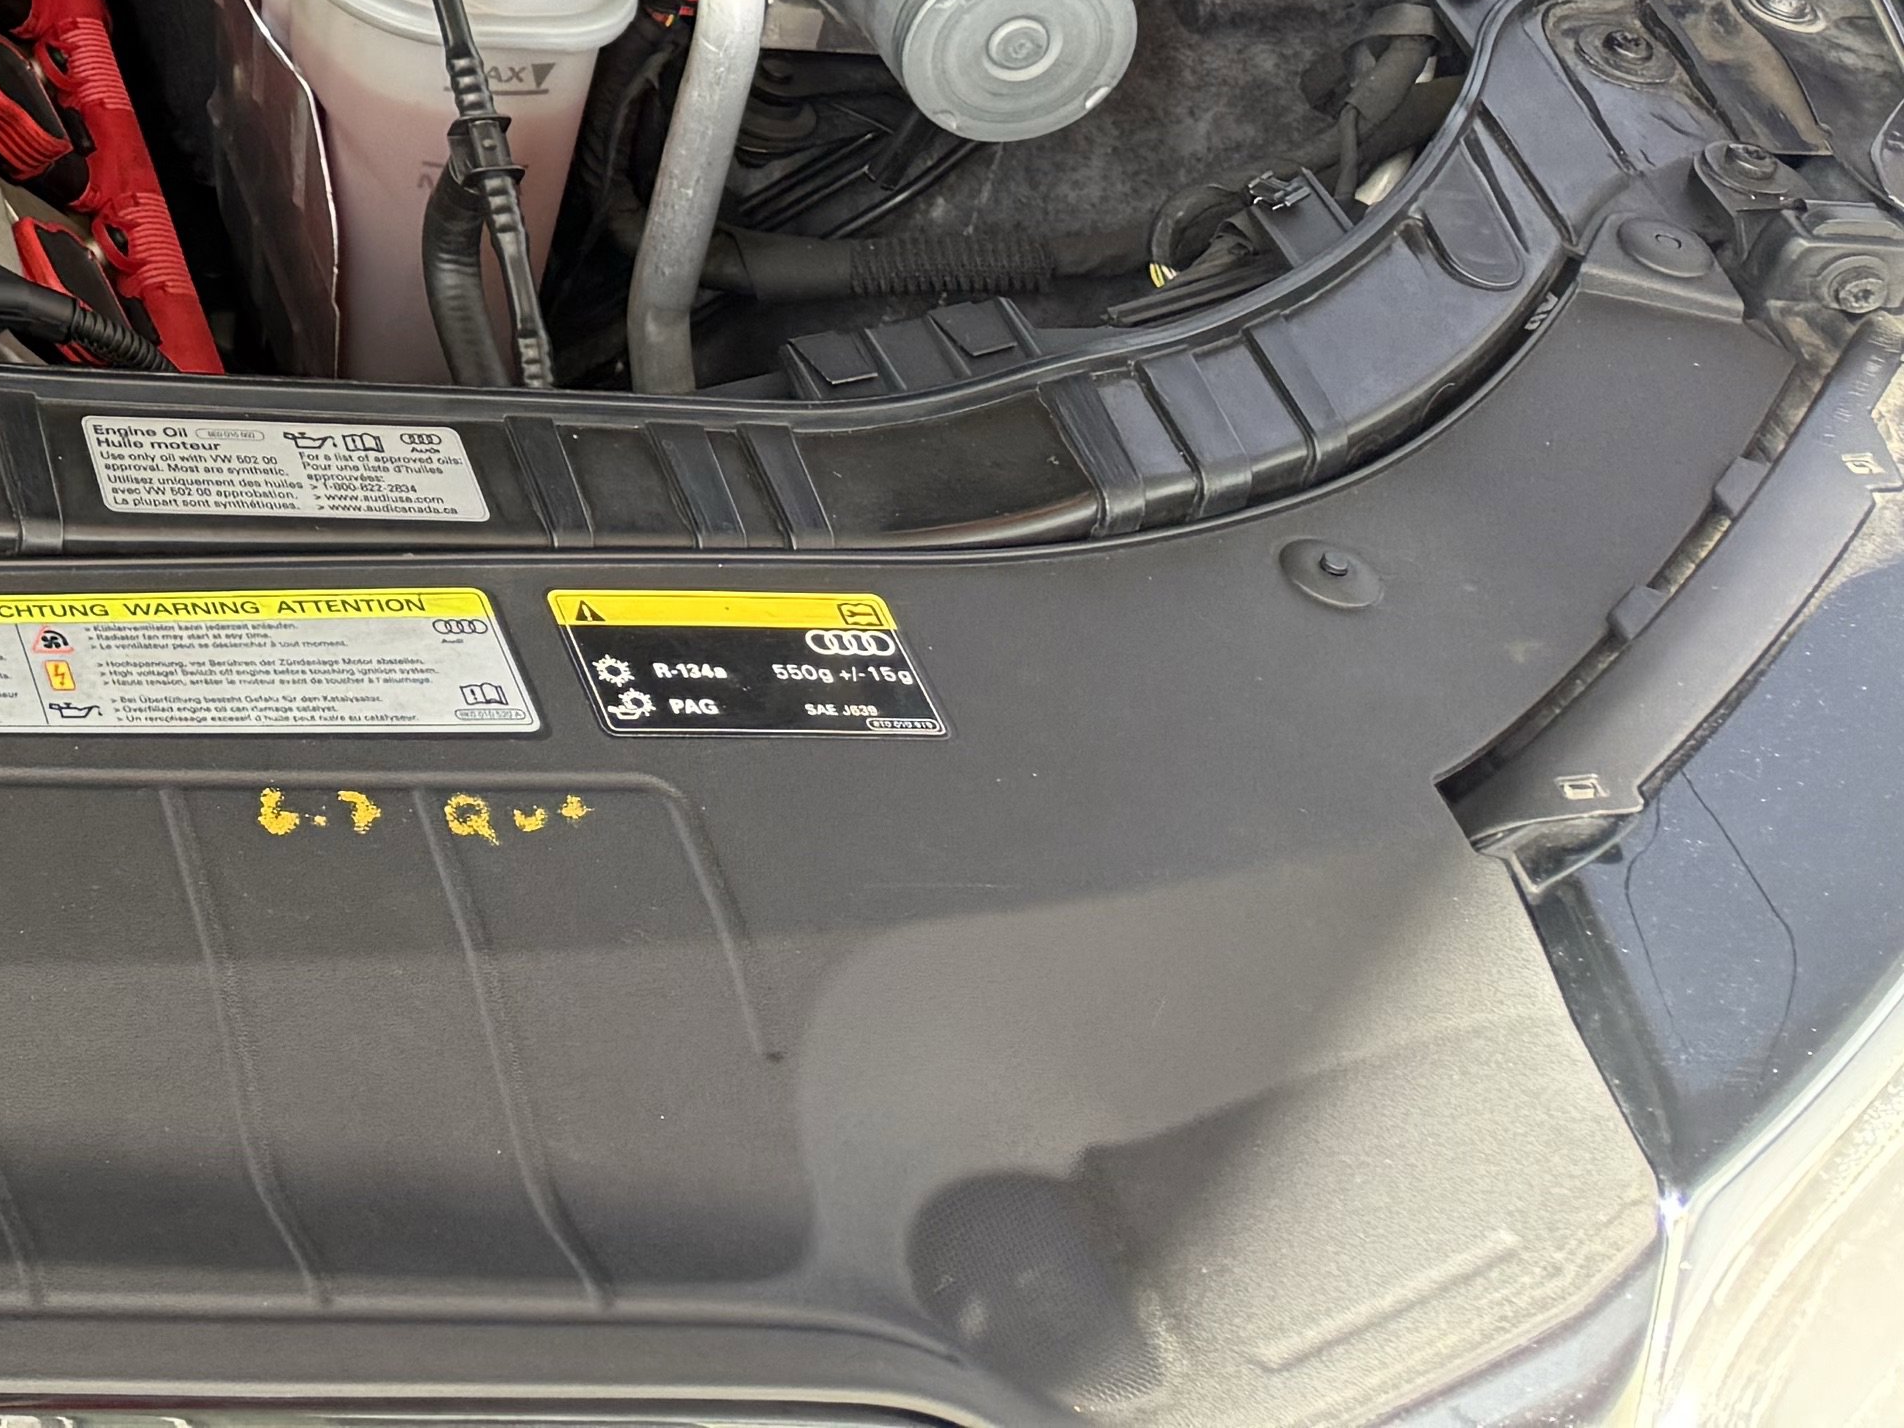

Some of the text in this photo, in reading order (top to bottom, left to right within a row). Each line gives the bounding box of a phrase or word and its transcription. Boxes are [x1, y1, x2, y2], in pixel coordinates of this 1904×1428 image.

[92, 424, 187, 437] Engine Oil
[95, 437, 220, 450] Huile moteur
[99, 450, 125, 460] Use
[127, 452, 155, 462] only
[159, 452, 176, 461] oil
[178, 454, 207, 463] with
[209, 454, 232, 463] VW
[261, 455, 277, 464] 00
[298, 451, 462, 465] For a list of approved oils:
[104, 462, 164, 472] approval.
[166, 463, 199, 473] Most
[226, 465, 288, 476] synthetic.
[301, 461, 331, 470] Pour
[362, 463, 390, 472] liste
[106, 473, 303, 489] Utilisez uniquement des huiles
[111, 486, 141, 494] avec
[142, 486, 165, 495] VW
[195, 487, 211, 496] 00
[215, 489, 297, 499] approbation.
[112, 495, 129, 505] La
[132, 496, 179, 507] plupart
[181, 499, 210, 507] sont
[125, 601, 261, 616] WARNING
[276, 599, 426, 615] ATTENTION
[652, 662, 729, 680] R-134a
[772, 663, 835, 685] 550g
[669, 698, 721, 717] PAG
[804, 702, 838, 717] SAE
